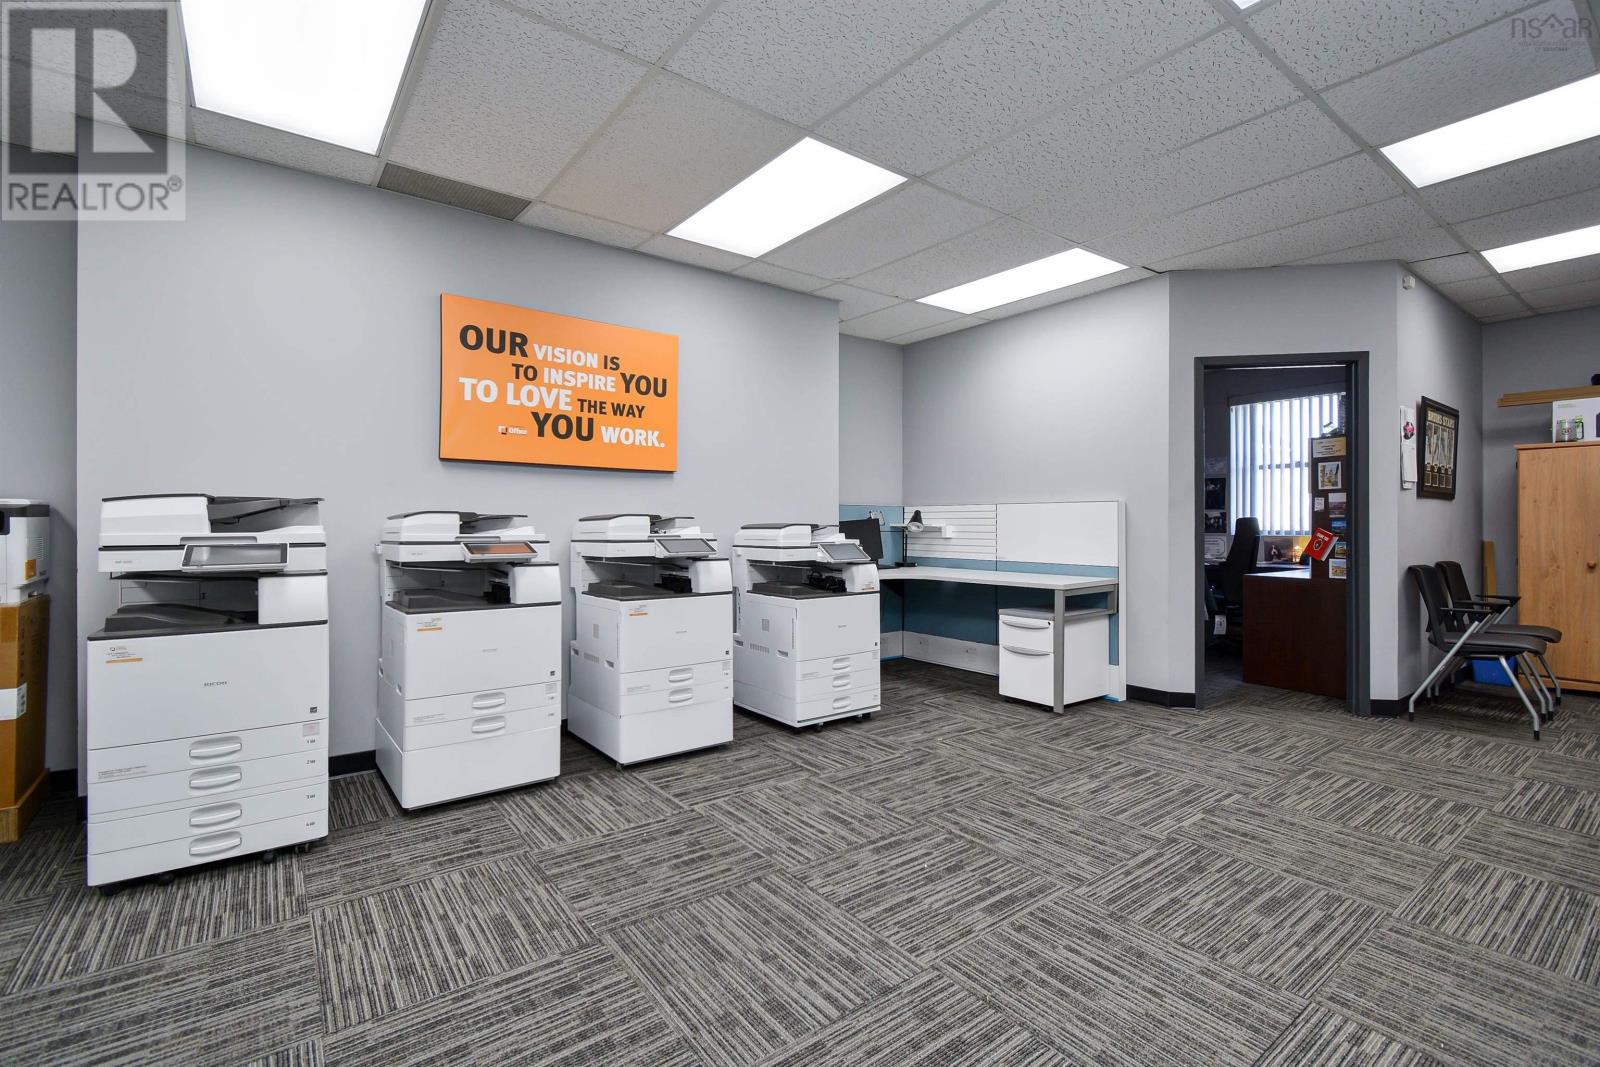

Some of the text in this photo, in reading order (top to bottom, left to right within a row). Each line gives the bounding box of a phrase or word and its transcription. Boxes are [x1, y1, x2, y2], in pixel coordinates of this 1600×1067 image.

[459, 324, 621, 371] OUR VISION IS
[458, 376, 646, 419] TO LOVE THE WAY
[512, 363, 668, 398] TO INSPIRE YOU
[531, 411, 665, 448] YOU WORK.
